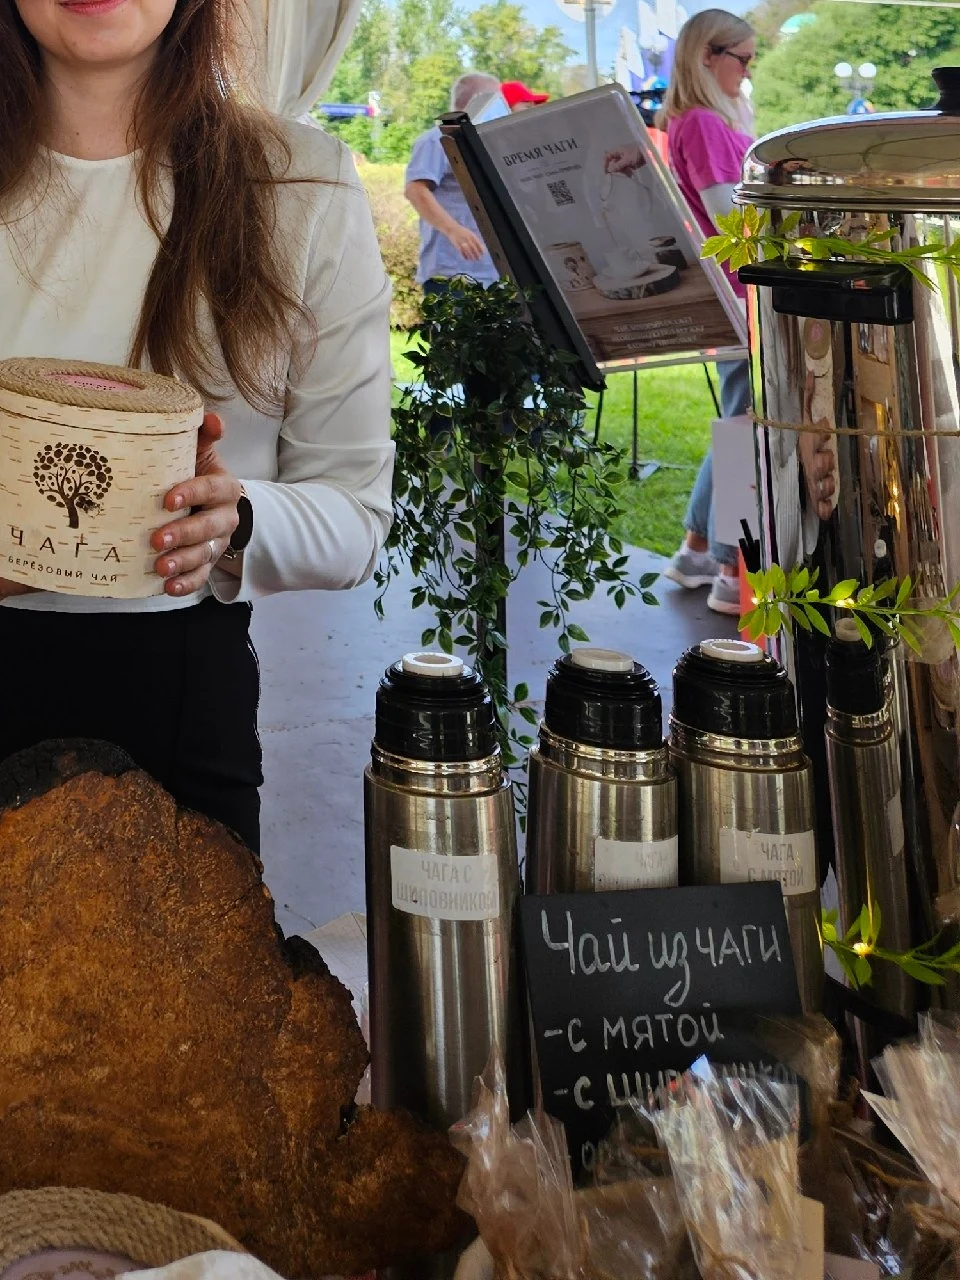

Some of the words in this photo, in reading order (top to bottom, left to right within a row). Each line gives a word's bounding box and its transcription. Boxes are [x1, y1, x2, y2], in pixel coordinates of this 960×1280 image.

[502, 146, 544, 167] ВРЕМЯ
[542, 137, 579, 155] ЧАГИ
[11, 526, 121, 563] ЧАГА
[8, 555, 84, 578] БЕРЁЗОВЫЙ
[91, 573, 118, 583] ЧАЙ
[760, 842, 796, 861] ЧАГА
[421, 860, 459, 883] ЧАГА
[463, 864, 472, 884] С
[396, 881, 498, 913] ШИПОВНИКОМ
[540, 909, 640, 976] Чай
[647, 929, 691, 1008] из
[694, 924, 783, 969] ЧАГИ
[602, 1003, 726, 1053] МЯТОЙ
